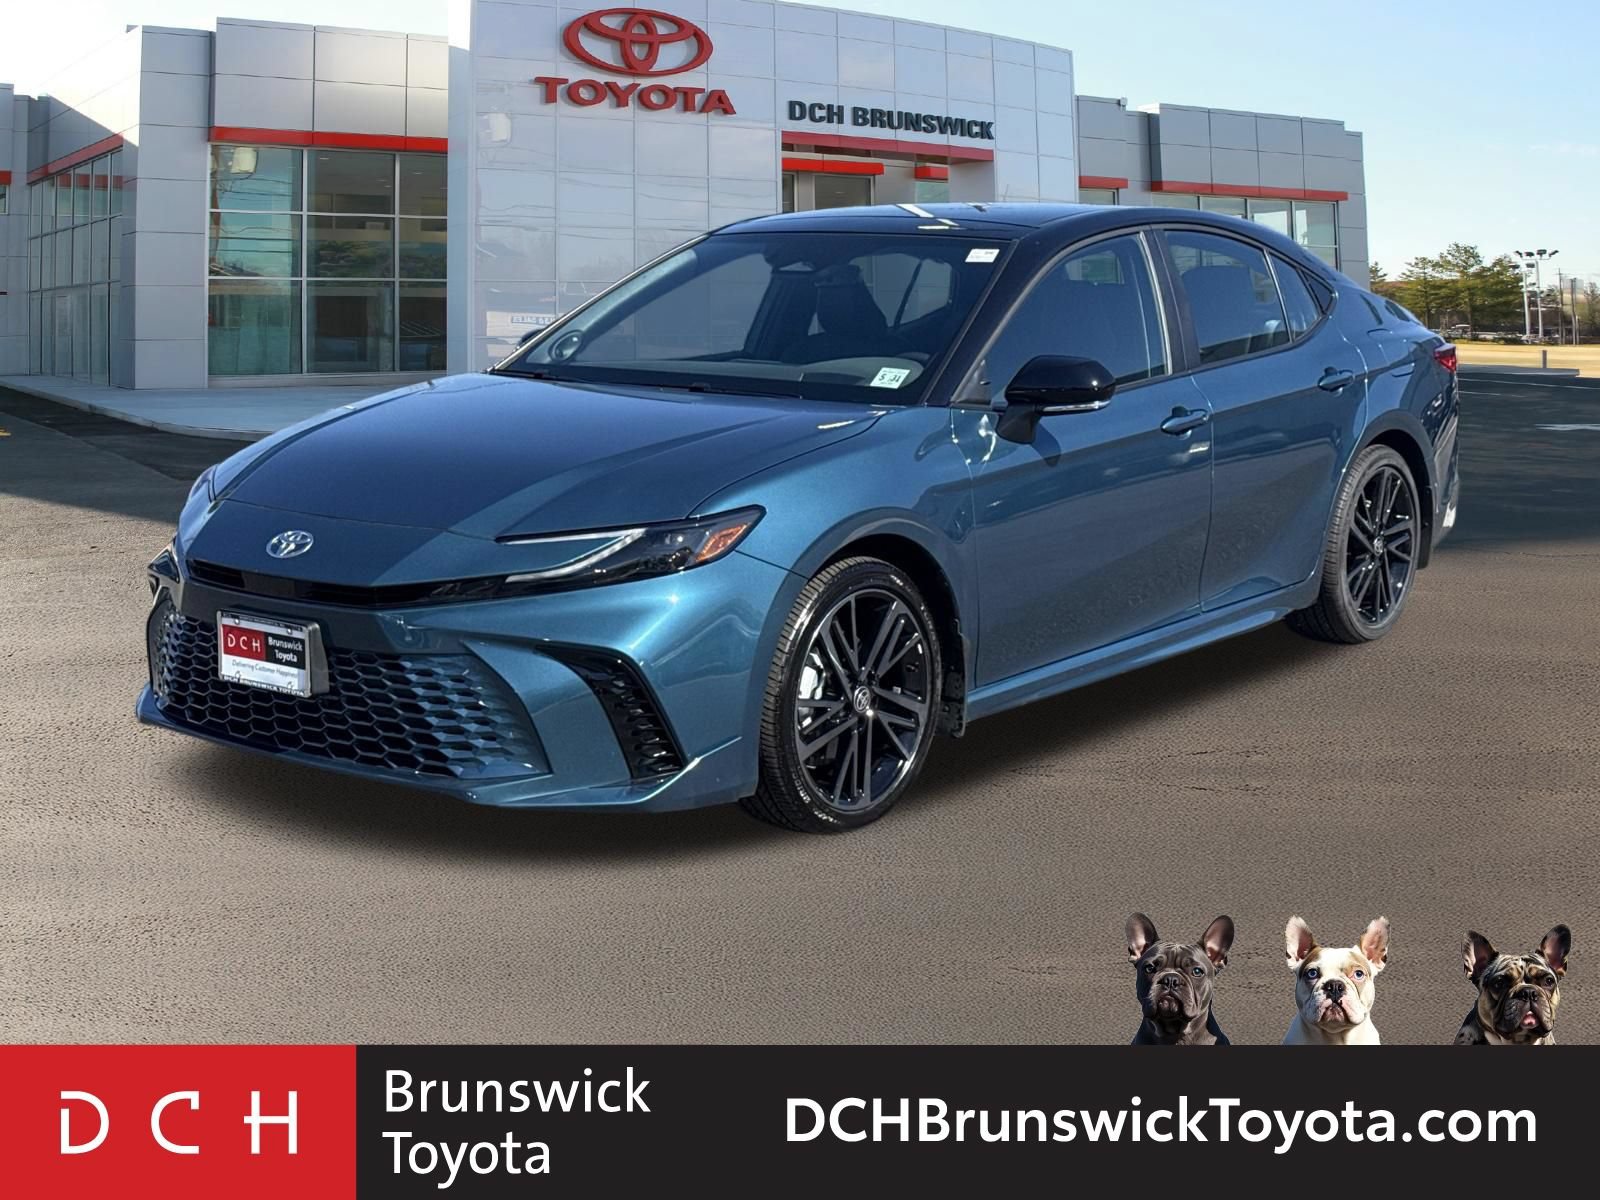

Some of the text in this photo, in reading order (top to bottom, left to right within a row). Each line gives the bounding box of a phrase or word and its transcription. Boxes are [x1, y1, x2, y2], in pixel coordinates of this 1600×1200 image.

[534, 76, 736, 115] TOYOTA
[788, 100, 994, 140] DCH BRUNSWICK
[268, 636, 303, 651] Brunswick
[274, 649, 298, 662] Toyota
